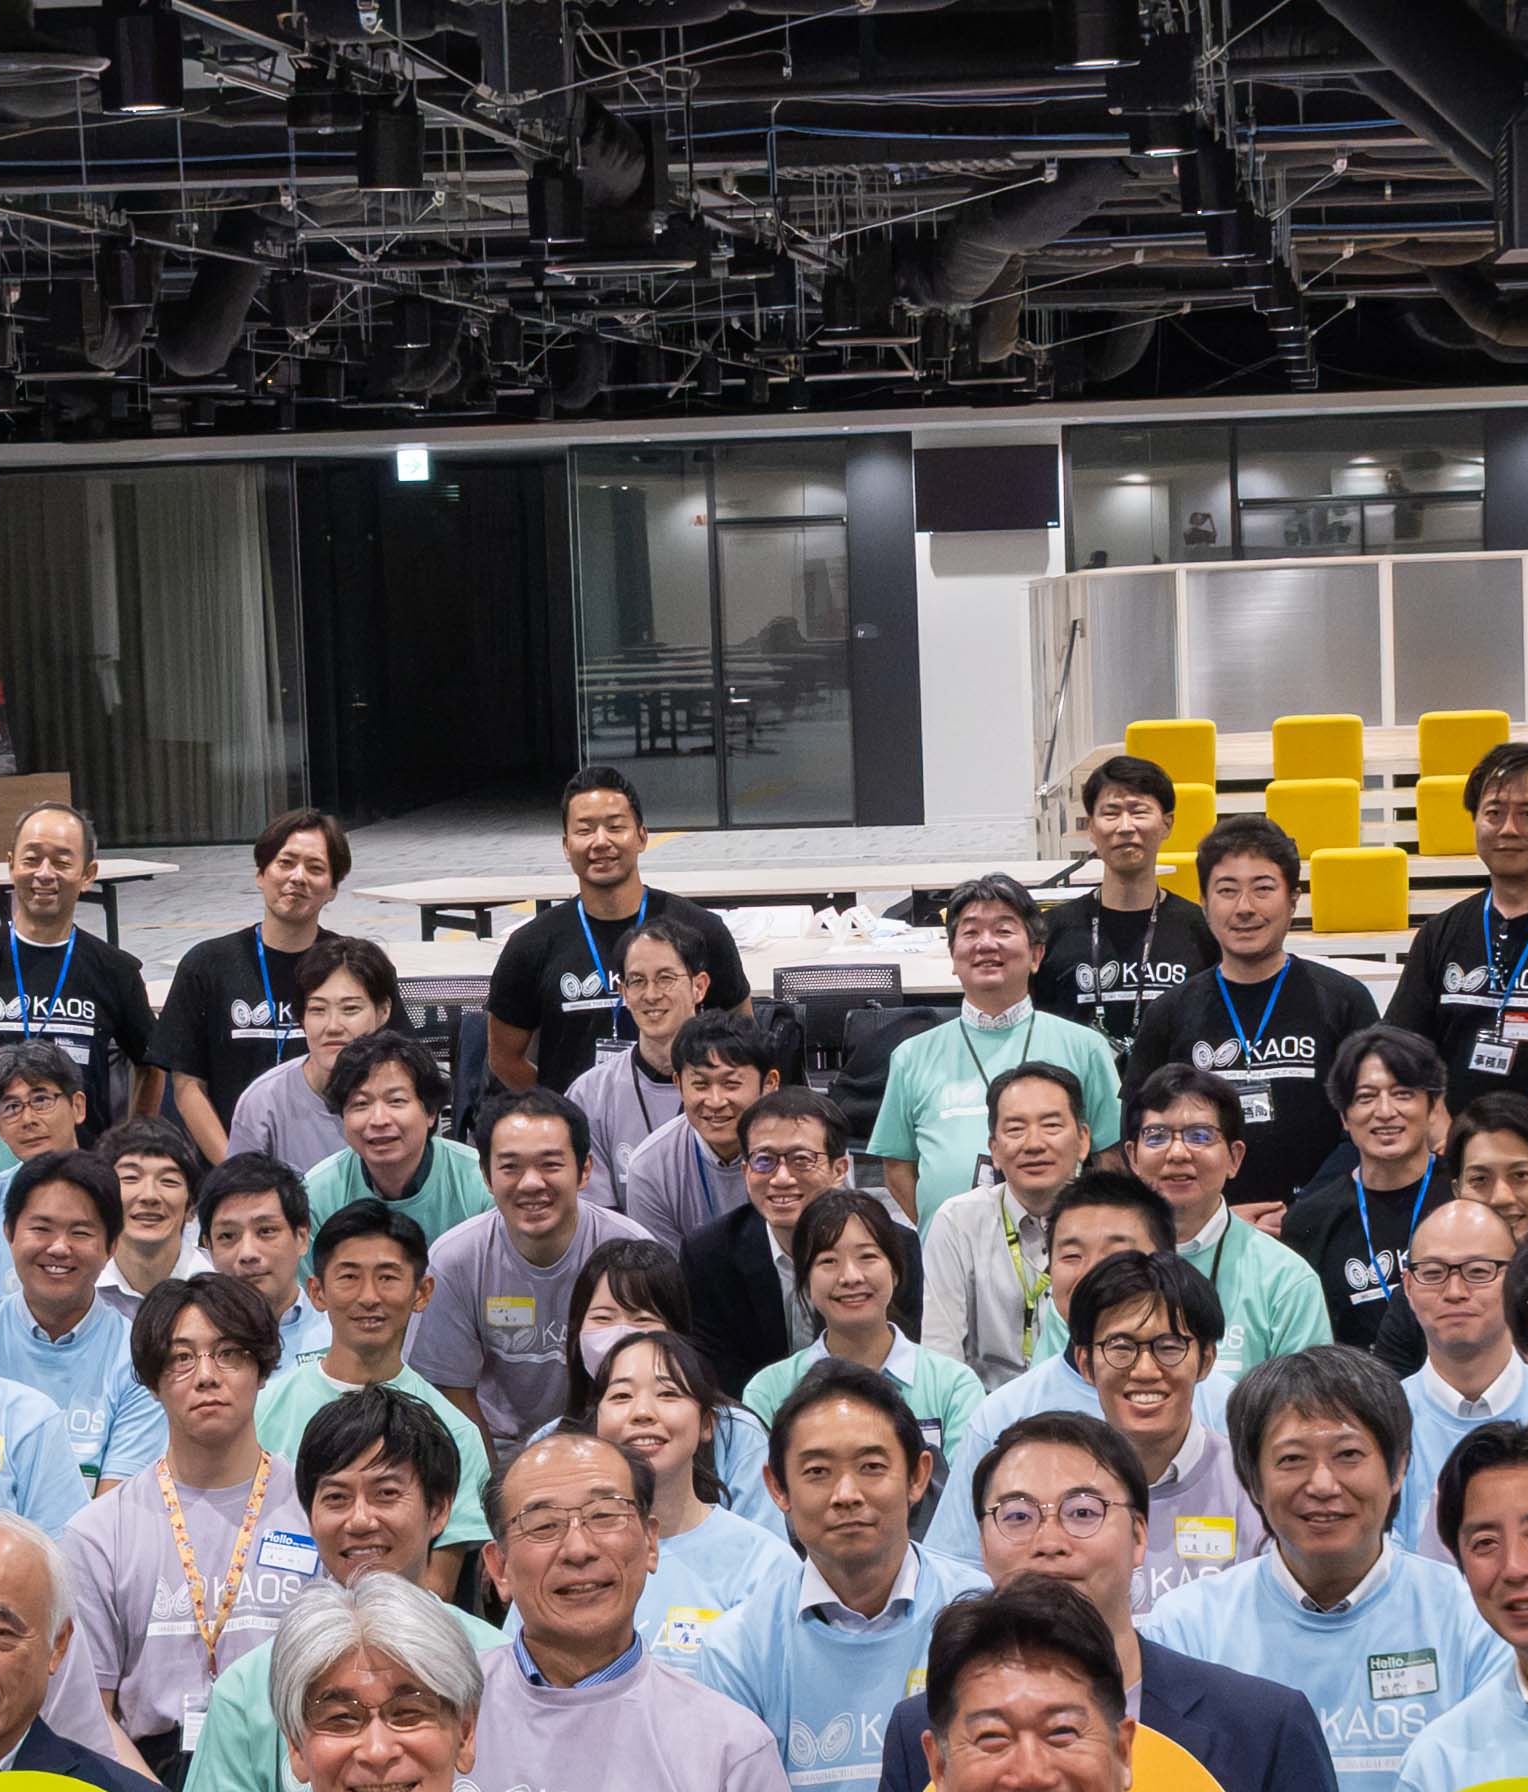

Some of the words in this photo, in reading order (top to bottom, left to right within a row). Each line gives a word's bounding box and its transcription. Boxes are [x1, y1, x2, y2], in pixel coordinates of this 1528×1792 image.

[1123, 962, 1186, 984] KAOS
[33, 996, 95, 1020] KAOS
[1244, 1036, 1315, 1061] KAOS
[264, 1530, 296, 1546] Hello
[212, 1574, 303, 1605] KAOS
[1370, 1655, 1404, 1670] Hello
[1320, 1703, 1426, 1742] KAOS
